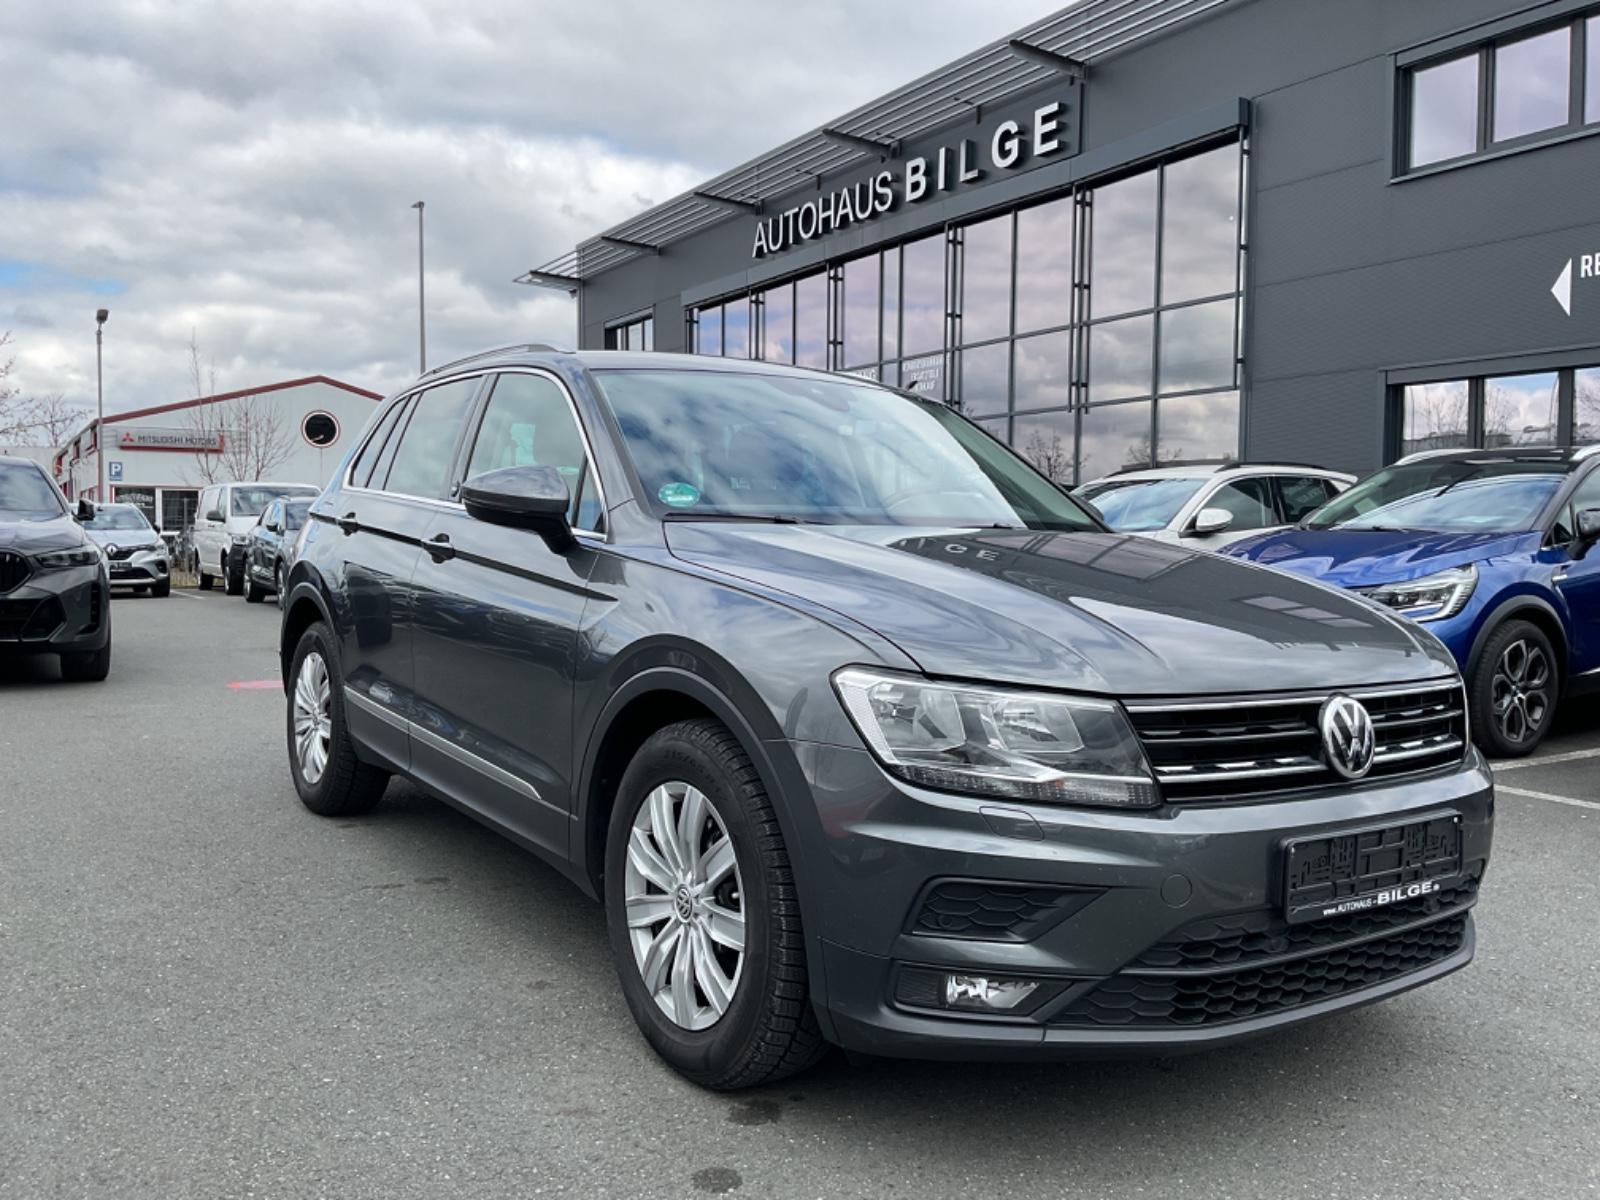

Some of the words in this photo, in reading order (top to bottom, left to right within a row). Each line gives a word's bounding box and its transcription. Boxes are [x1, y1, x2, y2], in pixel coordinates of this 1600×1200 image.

[752, 170, 893, 258] AUTOHAUS
[905, 101, 1060, 201] BILGE
[111, 463, 121, 475] P
